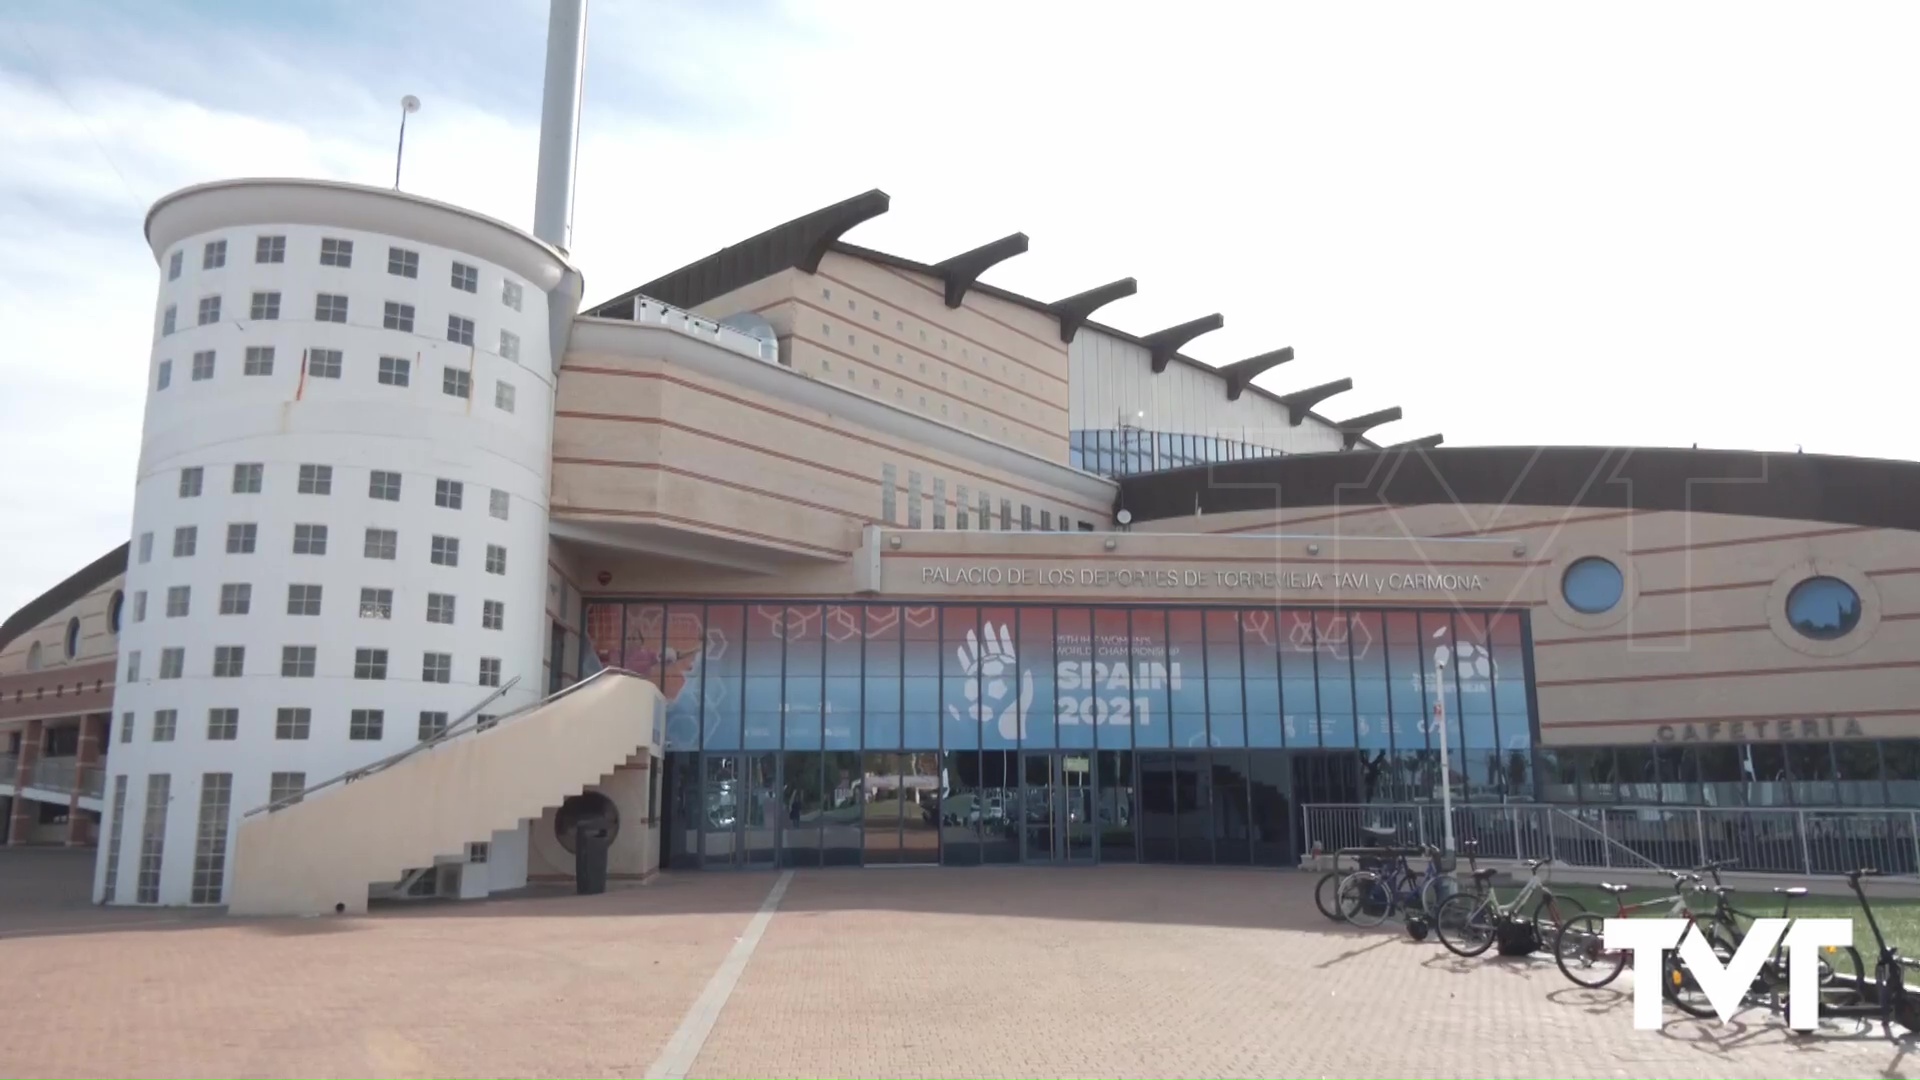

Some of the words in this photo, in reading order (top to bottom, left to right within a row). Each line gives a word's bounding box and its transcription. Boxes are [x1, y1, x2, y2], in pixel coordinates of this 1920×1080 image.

[922, 566, 1001, 585] PALACIO
[1007, 567, 1034, 586] DE
[1039, 568, 1075, 586] LOS
[1080, 568, 1179, 588] DEPORTES
[1184, 569, 1208, 587] DE
[1215, 570, 1324, 590] TORREVIEJA
[1374, 578, 1384, 594] y
[1056, 660, 1182, 691] SPAIN
[1053, 696, 1150, 726] 2021
